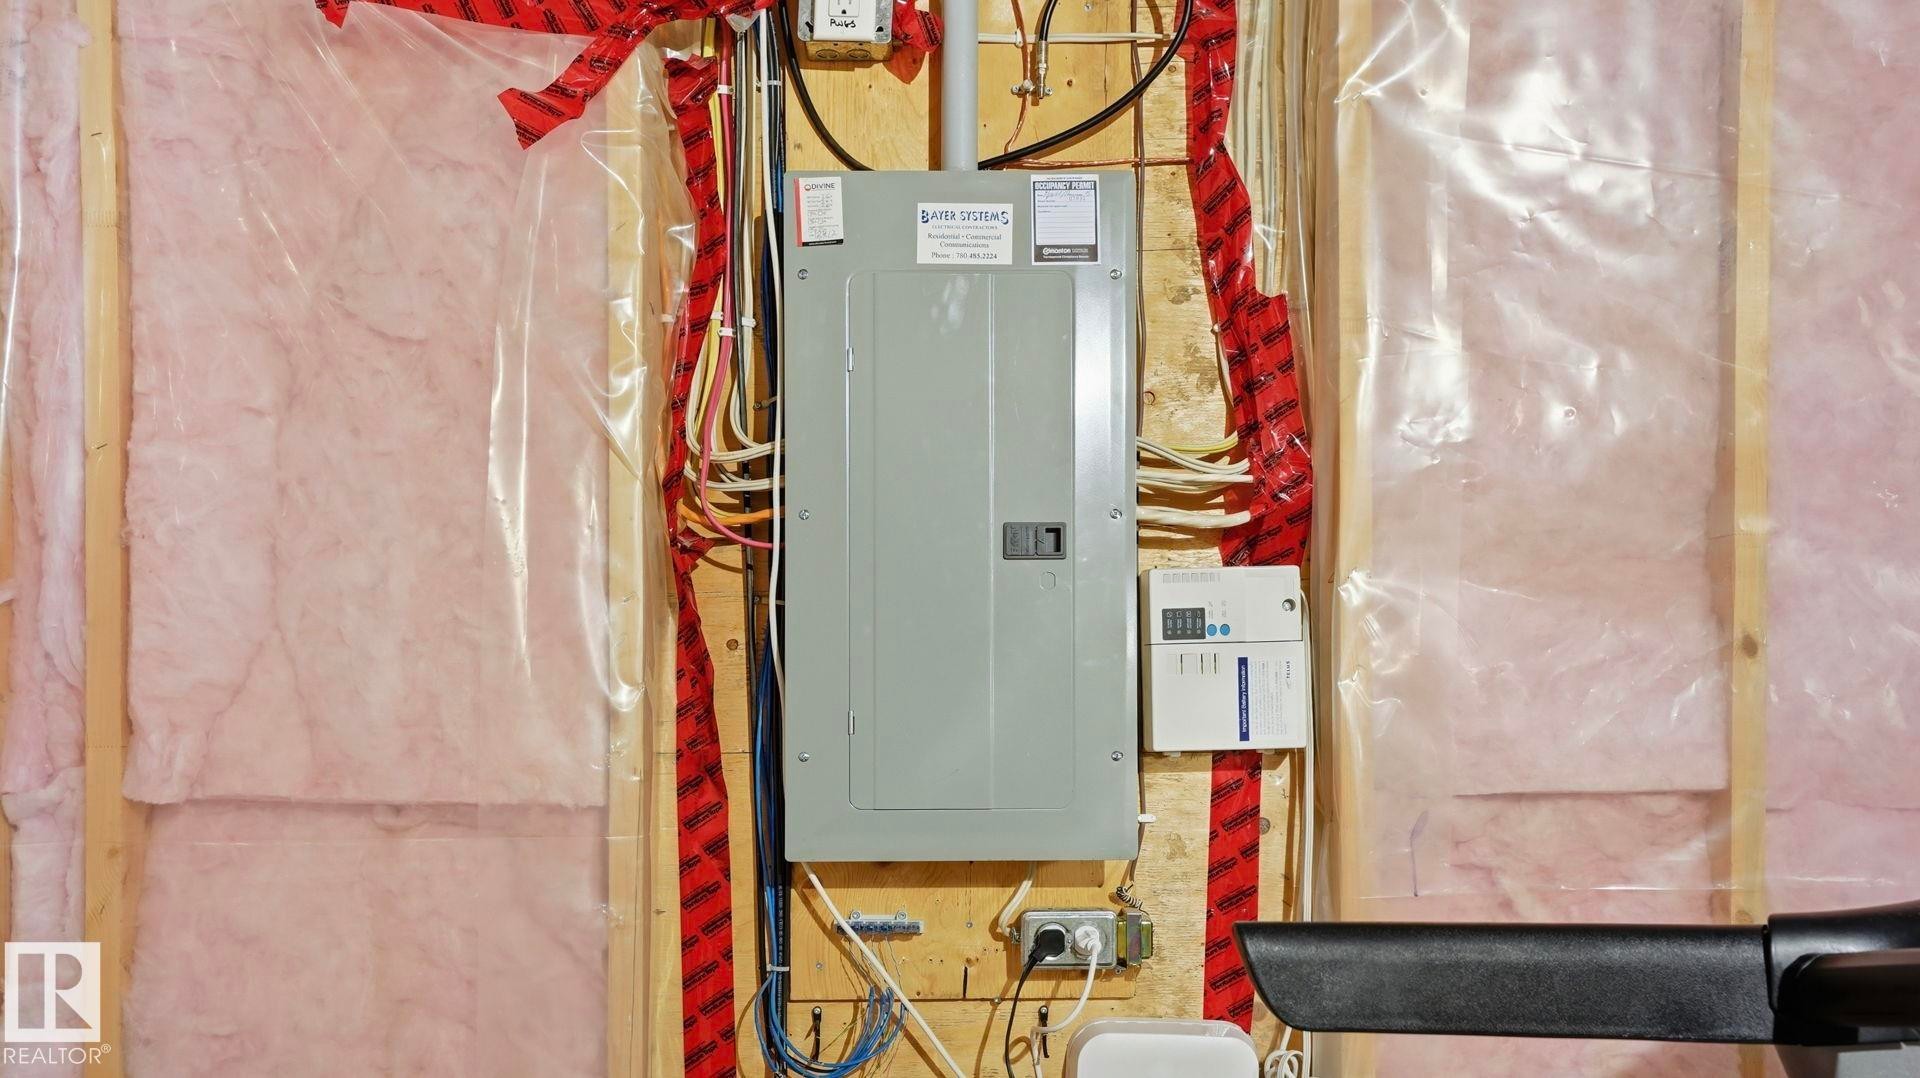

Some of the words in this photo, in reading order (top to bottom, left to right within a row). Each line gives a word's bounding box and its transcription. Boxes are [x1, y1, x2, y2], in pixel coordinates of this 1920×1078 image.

[1034, 181, 1070, 190] OCCUPANCY
[1072, 181, 1095, 190] PERMIT
[921, 209, 956, 224] BAYER
[960, 210, 1009, 225] SYSTEMS
[927, 232, 960, 240] Residential
[965, 233, 1002, 241] Commercial
[939, 241, 989, 249] Communications
